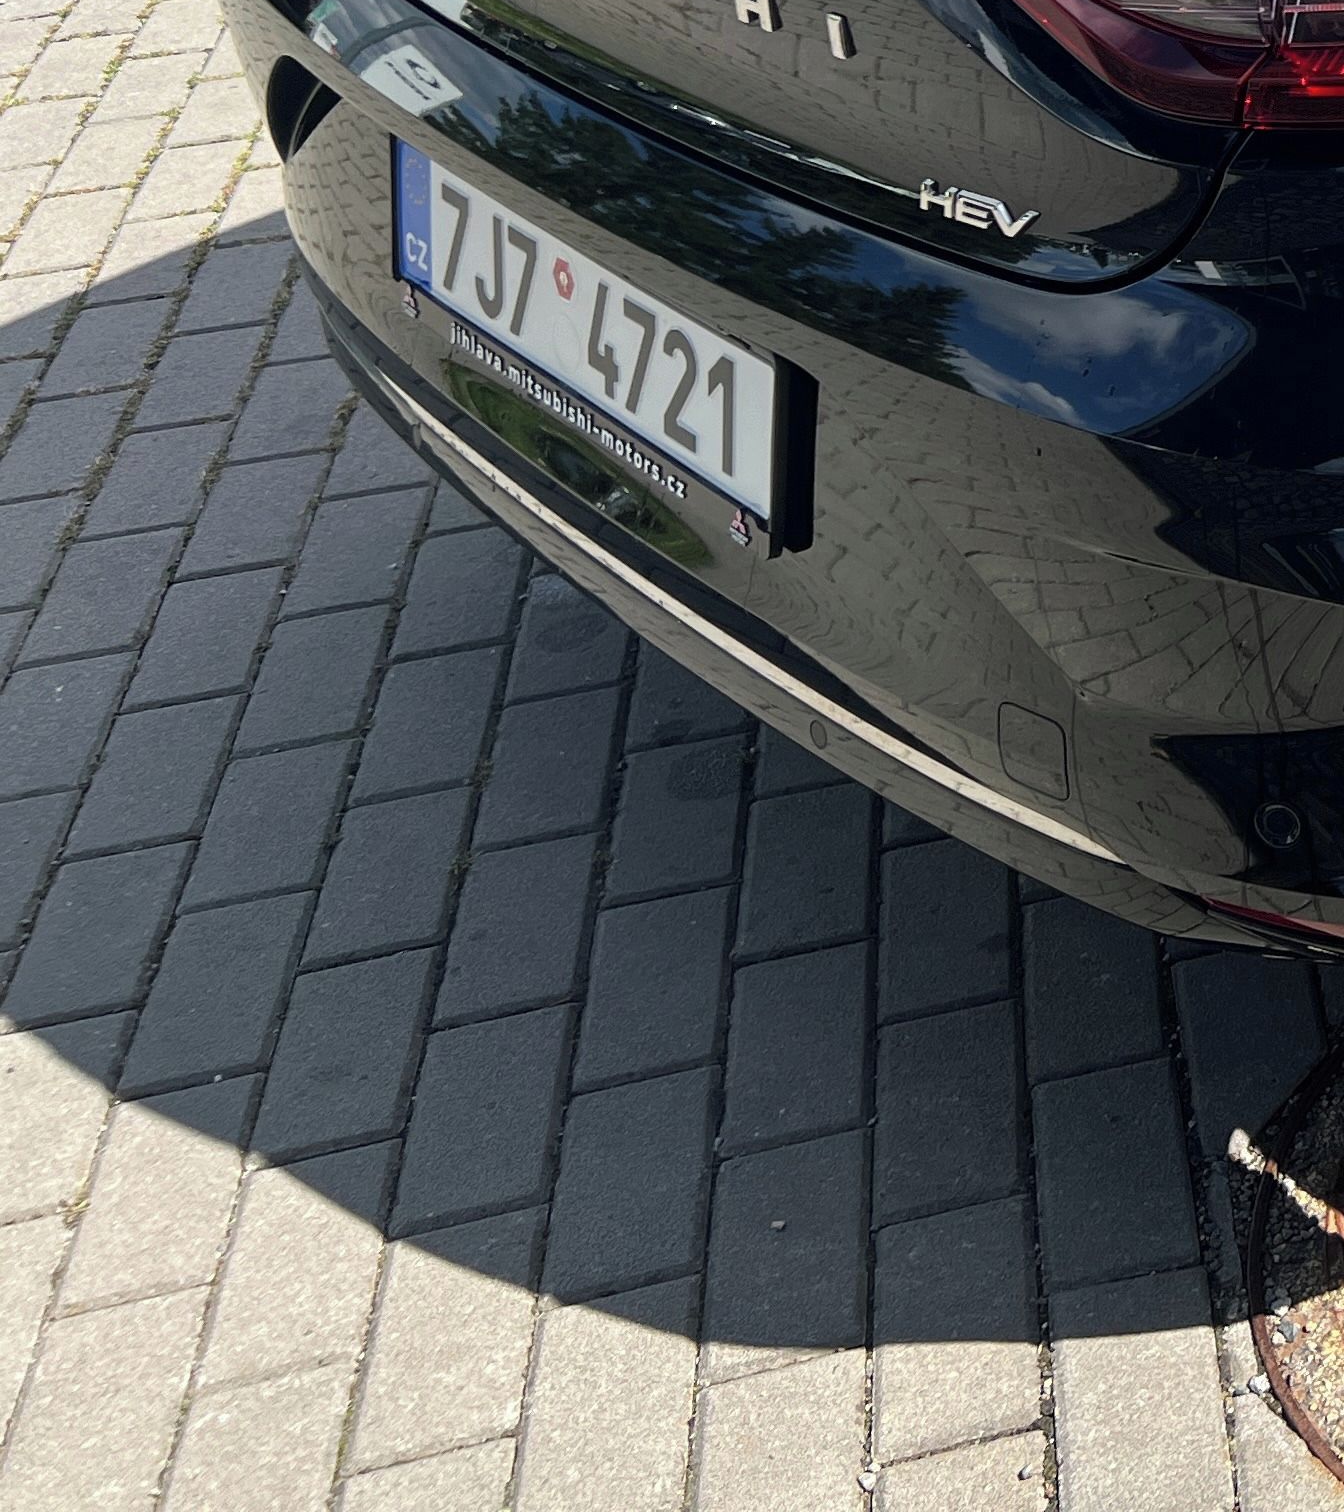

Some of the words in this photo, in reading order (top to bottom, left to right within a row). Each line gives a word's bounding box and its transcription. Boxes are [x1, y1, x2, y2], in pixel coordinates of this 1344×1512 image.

[920, 179, 1041, 238] HEV
[406, 231, 428, 272] CZ
[441, 182, 537, 337] 7J7
[588, 282, 734, 477] 4721
[450, 322, 687, 499] jihlava.mitsubishi-motors.cz
